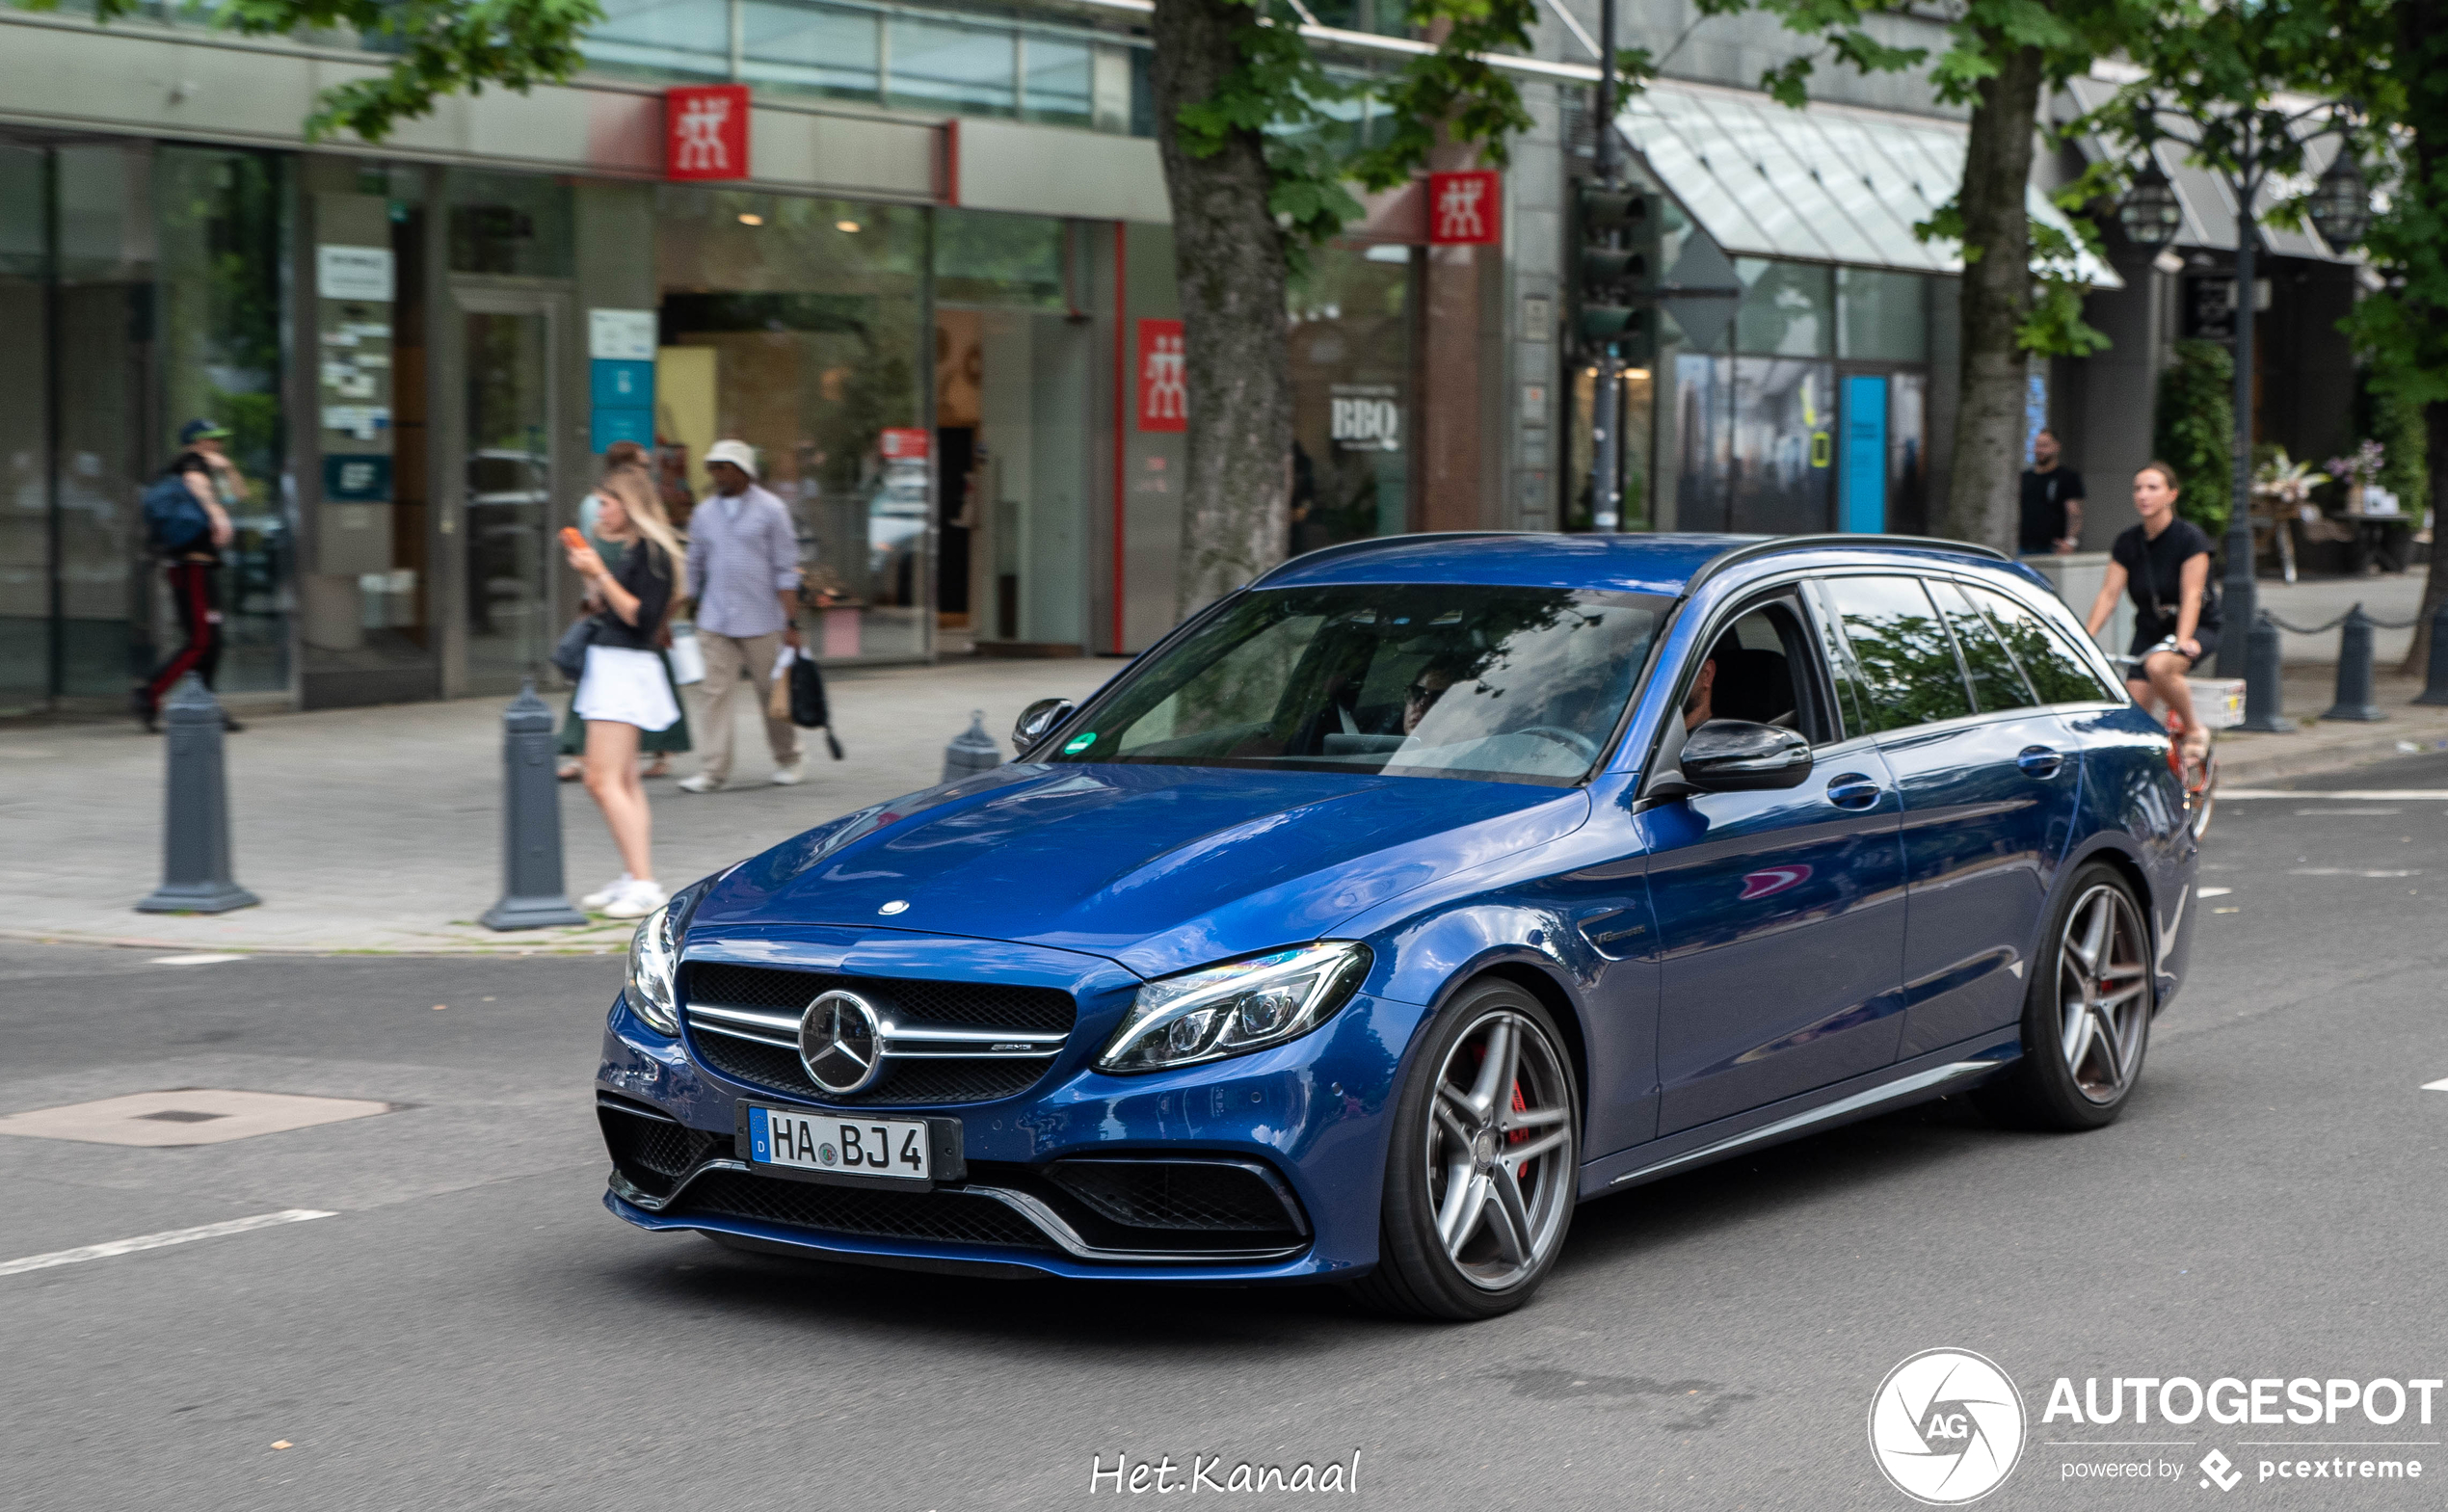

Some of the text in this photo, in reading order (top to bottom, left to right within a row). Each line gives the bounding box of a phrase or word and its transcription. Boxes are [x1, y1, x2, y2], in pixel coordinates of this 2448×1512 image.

[1331, 399, 1398, 450] BBQ
[757, 1140, 765, 1153] D
[772, 1117, 922, 1171] HA BJ 4
